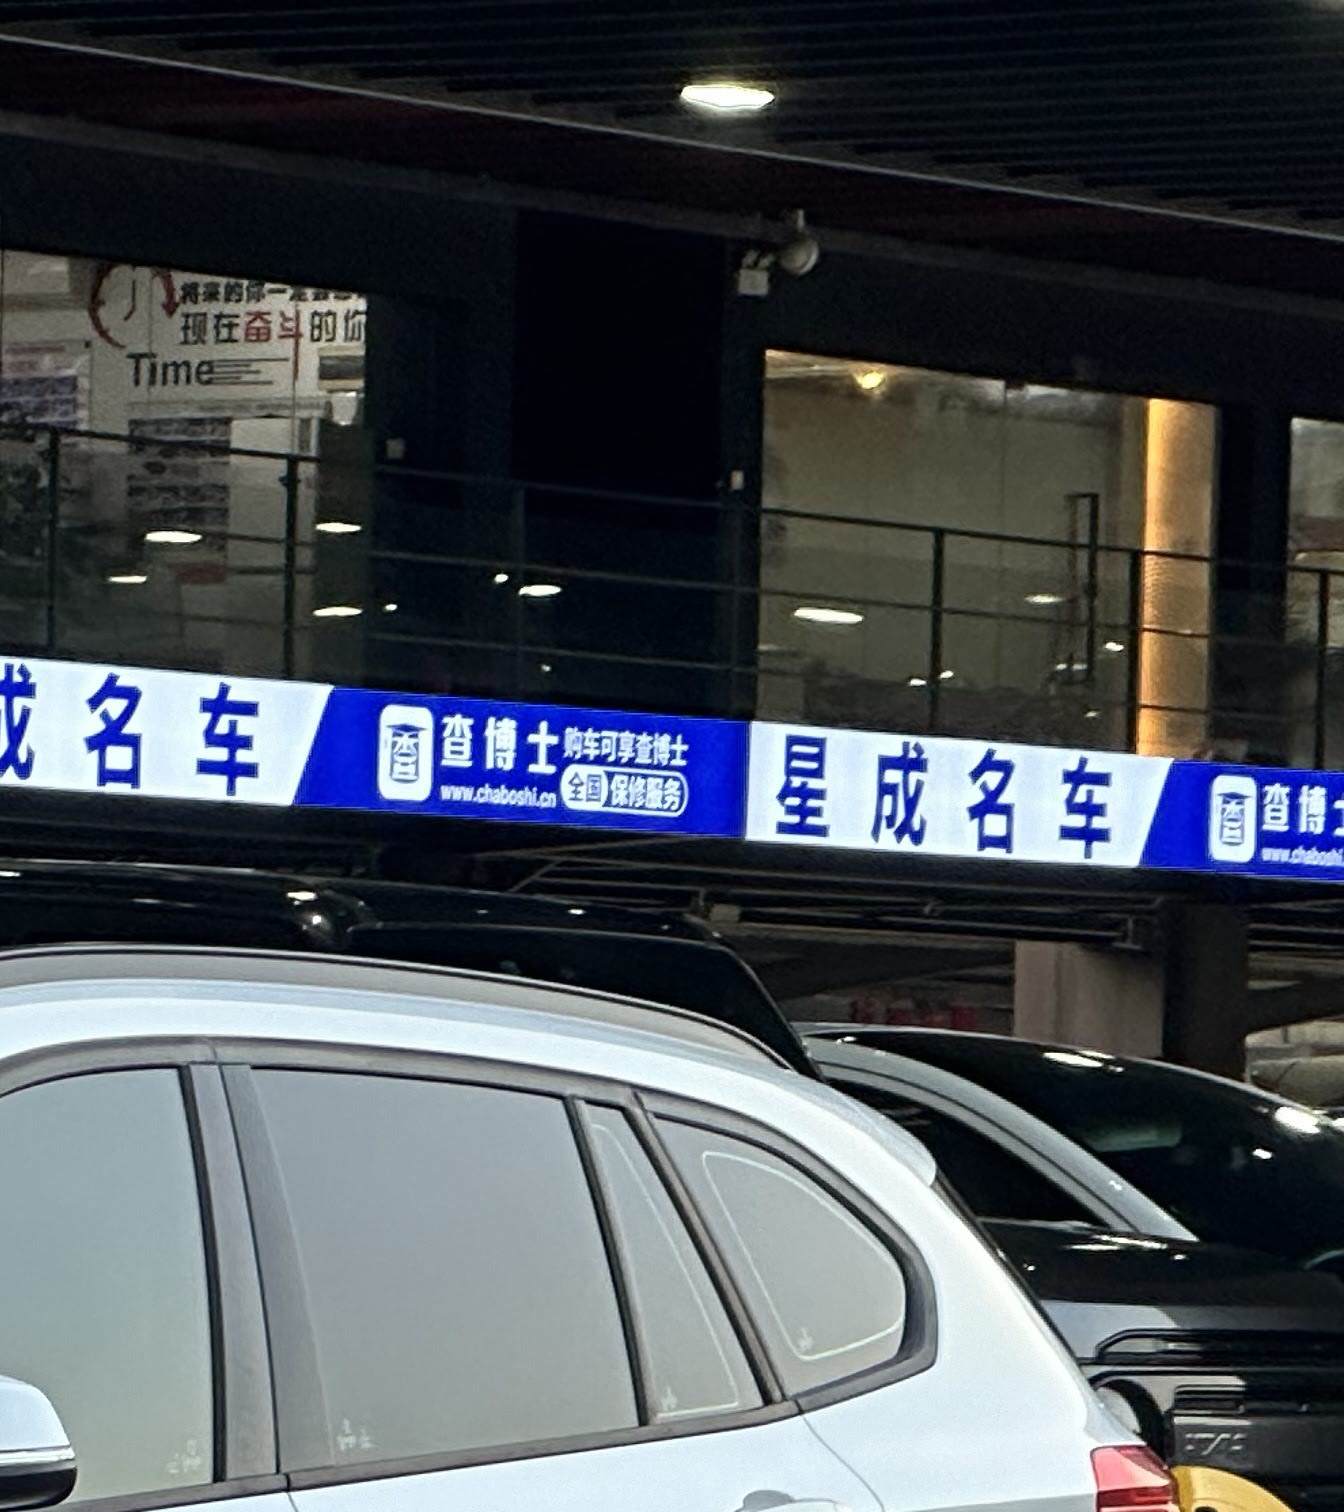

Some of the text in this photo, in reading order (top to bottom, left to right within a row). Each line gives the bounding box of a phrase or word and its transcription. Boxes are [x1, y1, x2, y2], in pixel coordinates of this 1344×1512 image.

[126, 352, 214, 387] Time
[440, 712, 560, 776] 查博士
[562, 725, 690, 768] 购车可享查博士
[439, 782, 558, 810] www.chaboshi.cn
[567, 771, 683, 813] 全国 保修服务
[775, 735, 1115, 862] 星成名车
